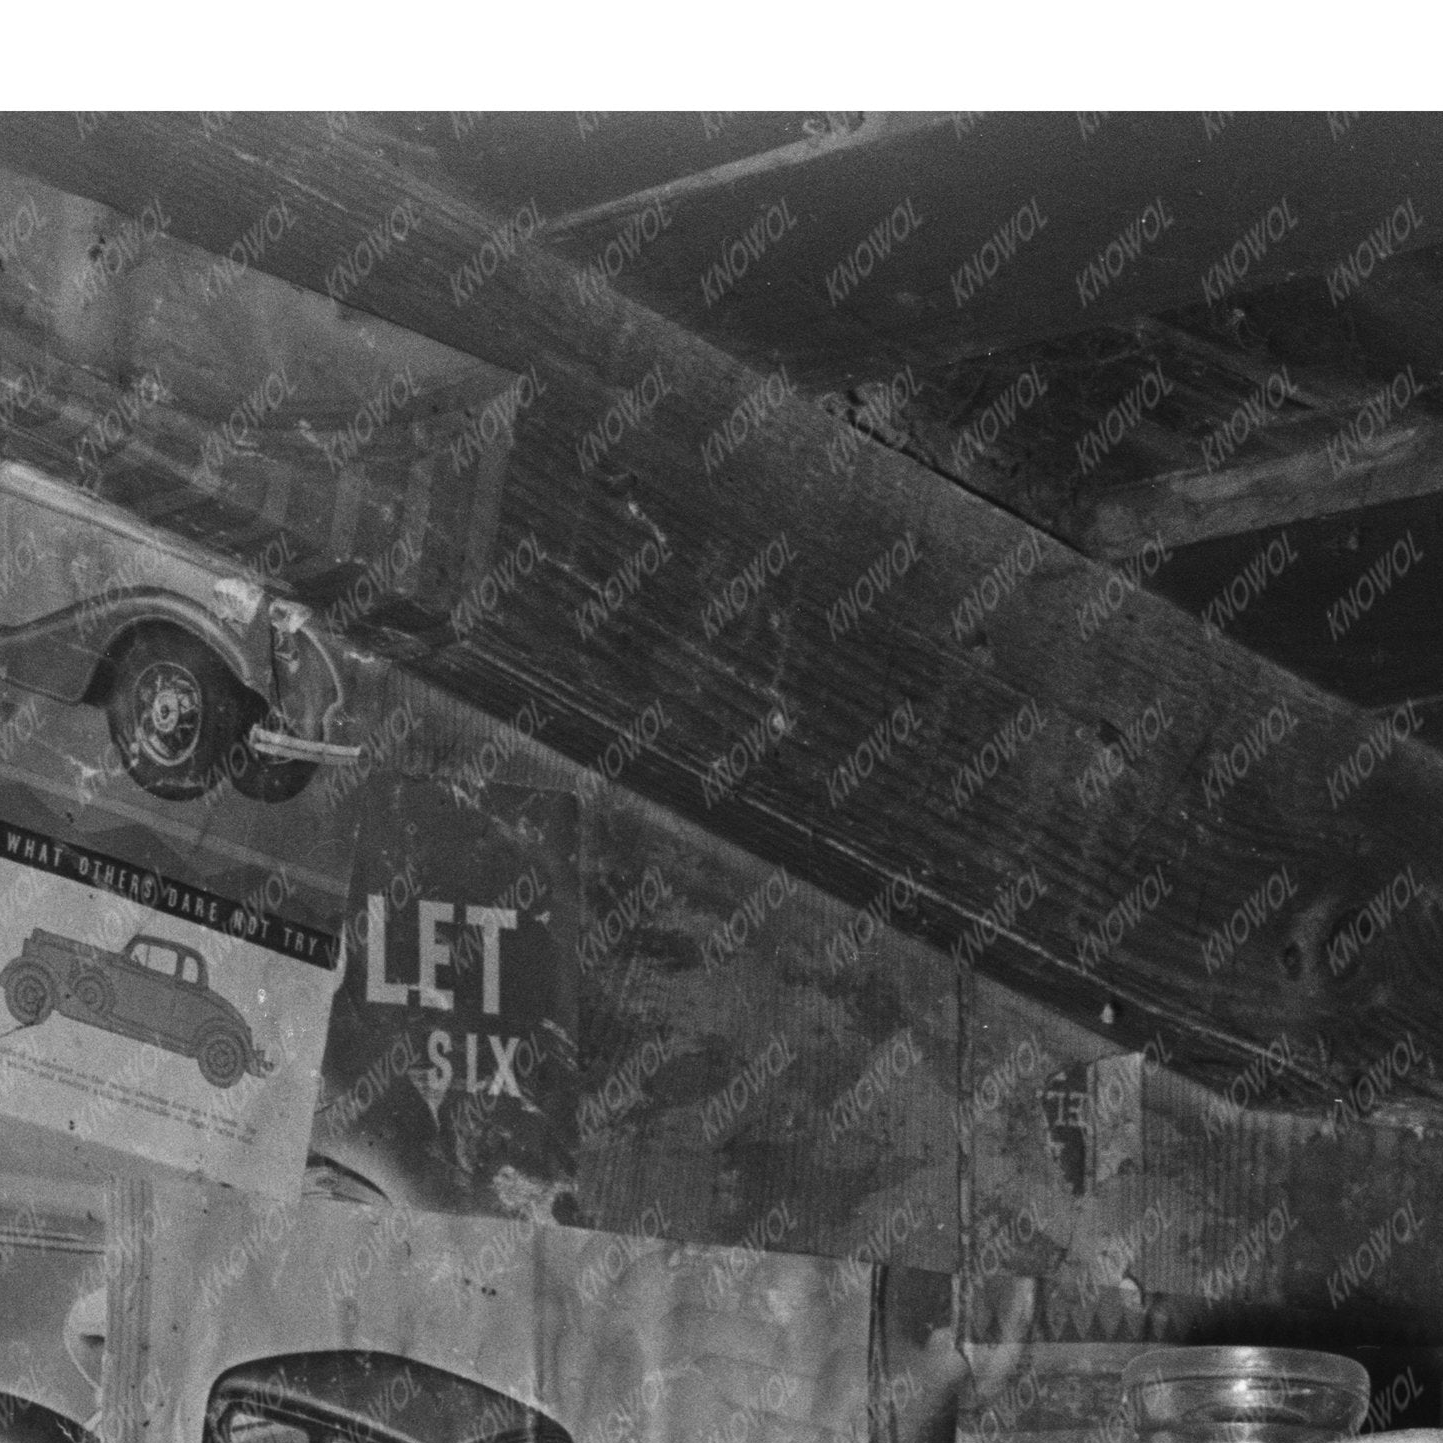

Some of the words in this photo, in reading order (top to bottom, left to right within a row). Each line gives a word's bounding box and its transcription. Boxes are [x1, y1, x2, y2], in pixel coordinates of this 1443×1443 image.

[6, 832, 63, 867] WHAT
[78, 856, 153, 898] OTHERS
[168, 887, 218, 922] DARE
[231, 910, 271, 939] NOT
[285, 927, 320, 957] TRY
[366, 894, 518, 1015] LET
[428, 1030, 523, 1098] SIX
